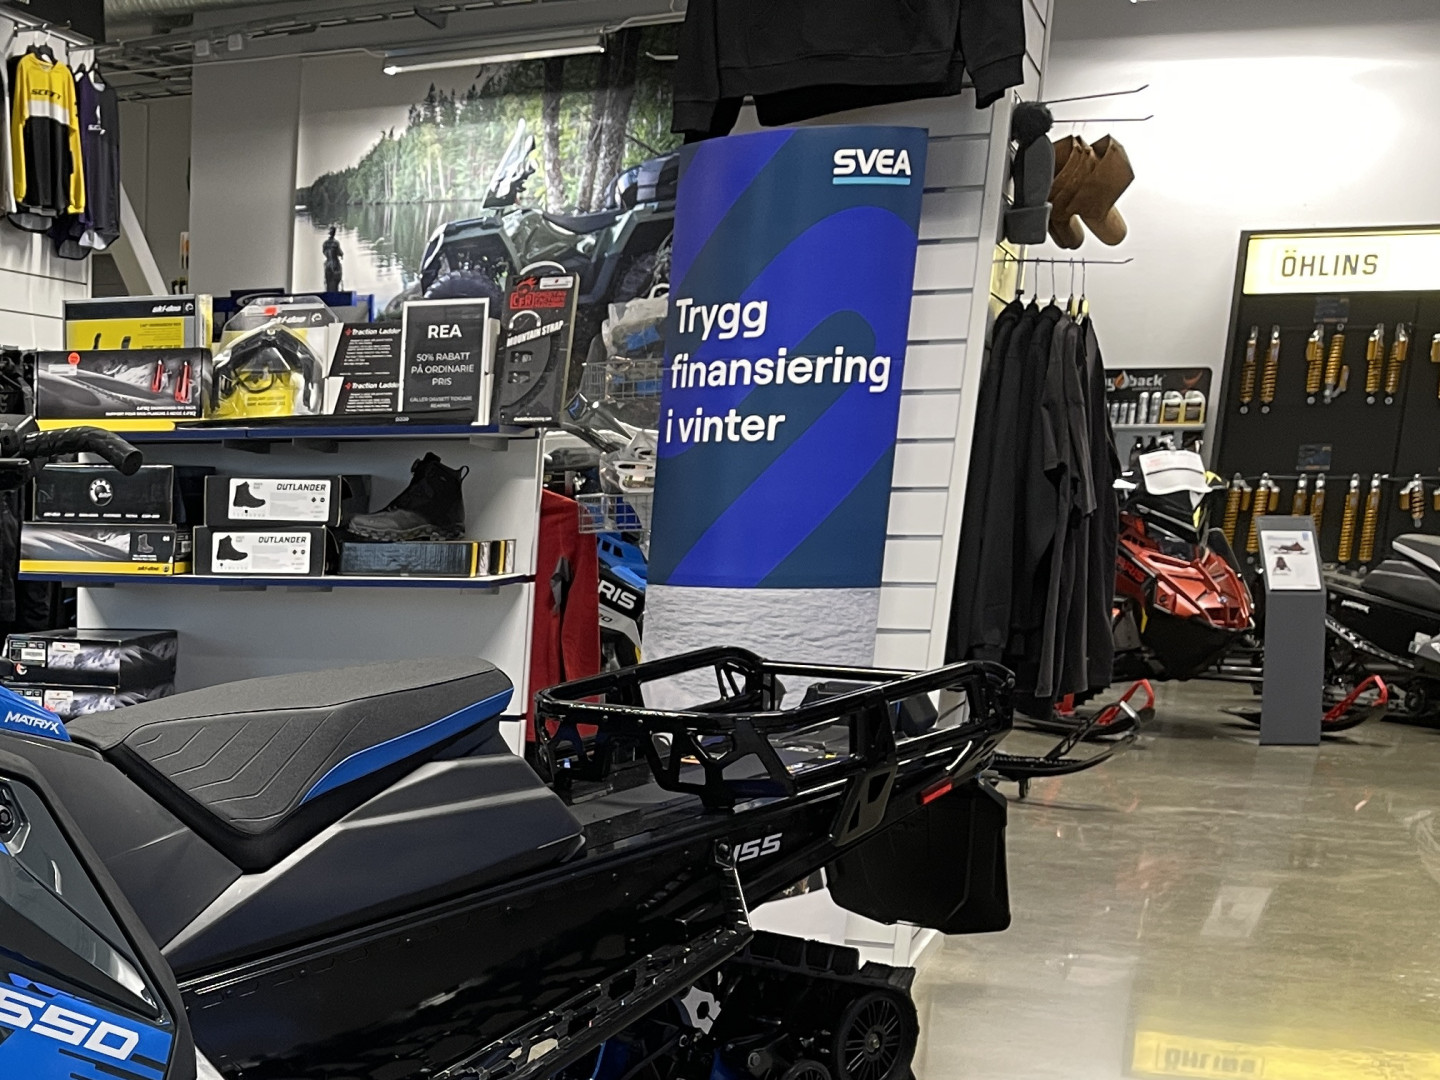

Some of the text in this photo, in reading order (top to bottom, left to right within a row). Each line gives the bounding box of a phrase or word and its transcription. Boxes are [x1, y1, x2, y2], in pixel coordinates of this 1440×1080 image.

[833, 148, 912, 177] SVEA
[1281, 249, 1379, 277] ÖHLINS
[352, 327, 402, 336] Traction Ladder
[427, 323, 463, 339] REA
[675, 298, 769, 341] Trygg
[506, 319, 564, 348] MOUNTAIN STRAP
[410, 363, 475, 374] PÅ ORDINARIE
[416, 351, 471, 362] 50% RABATT
[432, 377, 453, 386] PRIS
[670, 346, 892, 393] finansiering
[352, 382, 378, 390] Traction
[665, 408, 787, 444] i vinter
[276, 483, 327, 492] OUTLANDER
[258, 536, 307, 544] OUTLANDER
[598, 579, 637, 610] RIS
[4, 710, 60, 735] MATRYX
[733, 832, 783, 862] 155
